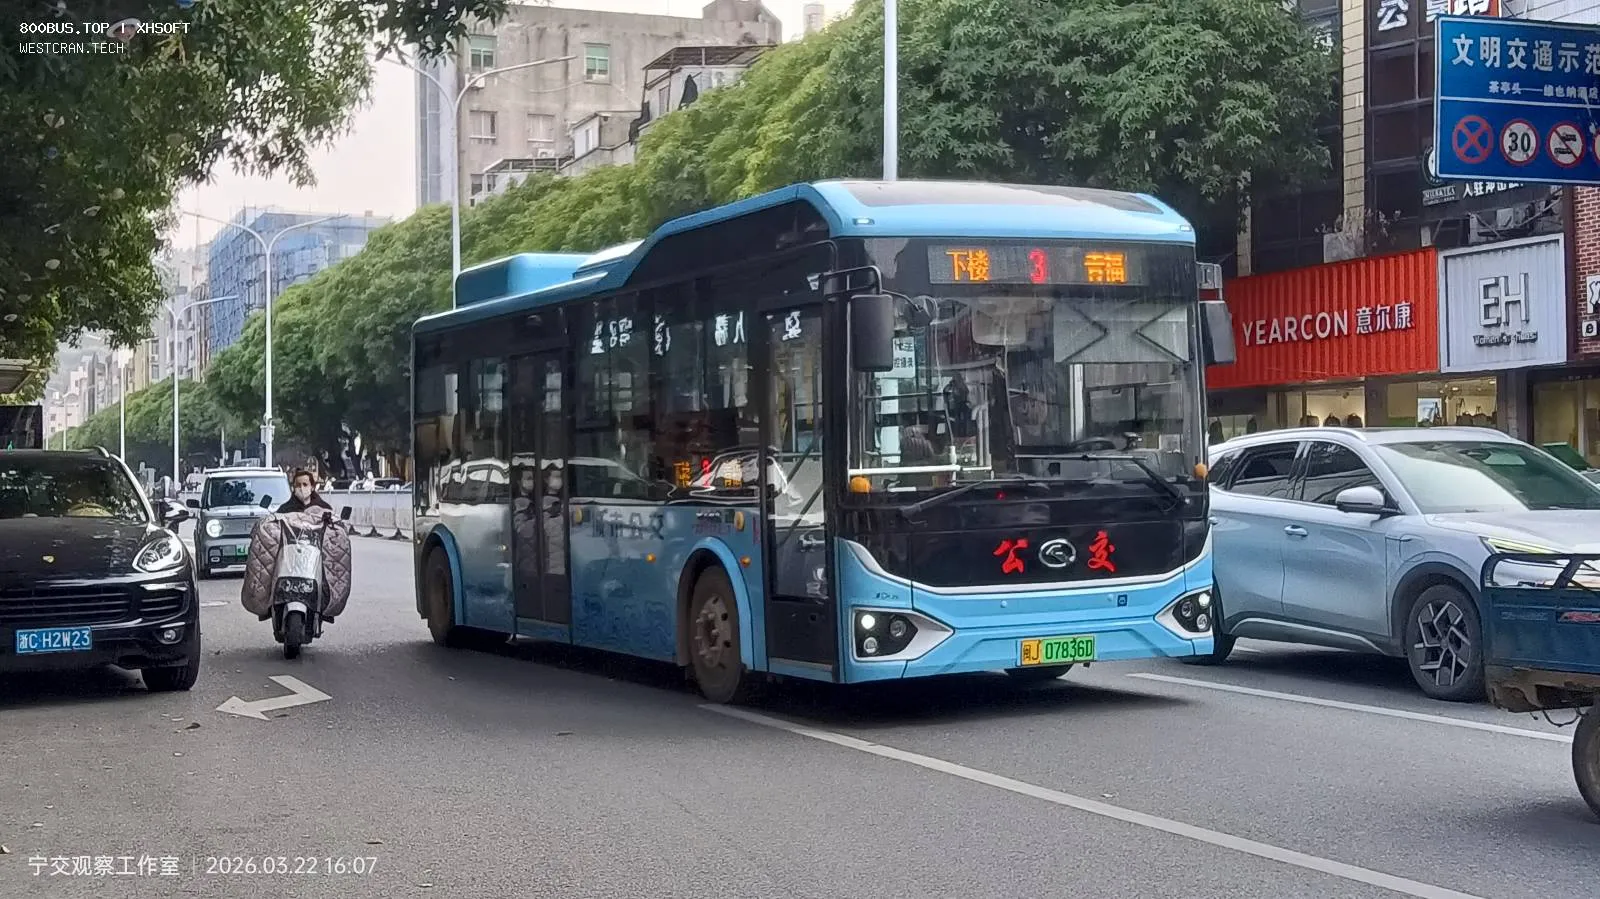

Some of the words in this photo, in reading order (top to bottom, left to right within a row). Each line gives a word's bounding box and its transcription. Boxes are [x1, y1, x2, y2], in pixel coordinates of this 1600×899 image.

[1508, 131, 1531, 152] 30
[946, 249, 990, 281] 下楼
[1029, 249, 1048, 283] 3
[1478, 273, 1530, 326] EH
[1242, 309, 1348, 346] YEARCON
[1356, 301, 1414, 335] 意尔康
